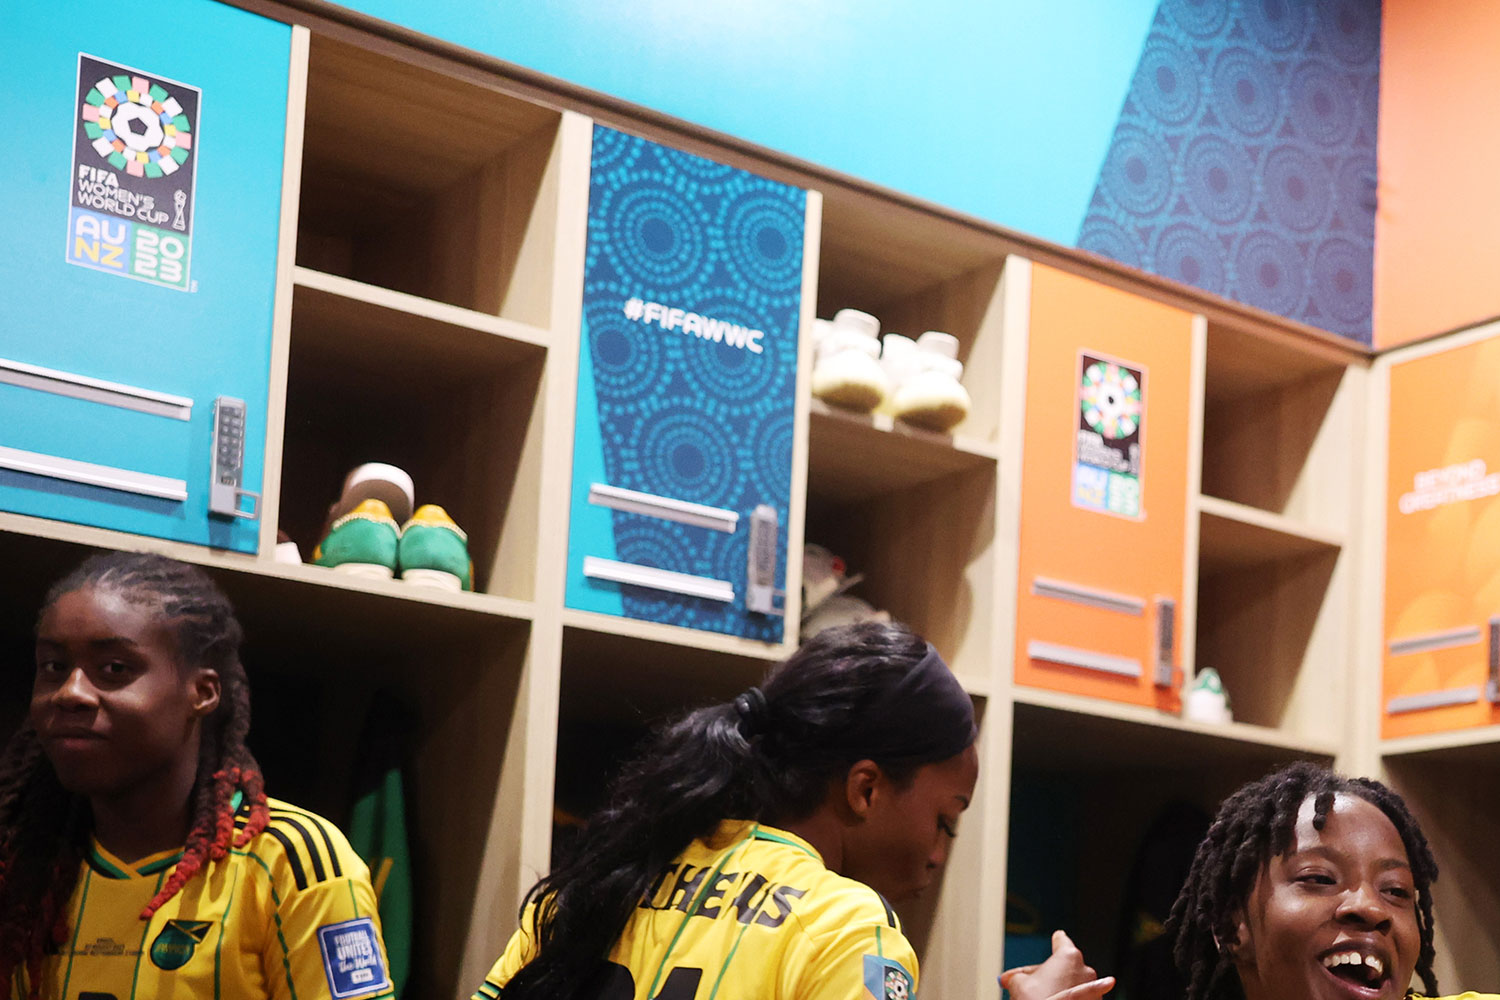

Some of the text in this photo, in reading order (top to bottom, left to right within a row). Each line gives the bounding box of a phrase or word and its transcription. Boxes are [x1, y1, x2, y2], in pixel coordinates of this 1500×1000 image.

[79, 164, 119, 187] FIFA
[77, 191, 170, 225] WORLD CUP
[75, 214, 126, 244] AU
[136, 228, 184, 260] 20
[75, 236, 124, 268] NZ
[623, 297, 765, 355] #FIFAWWC
